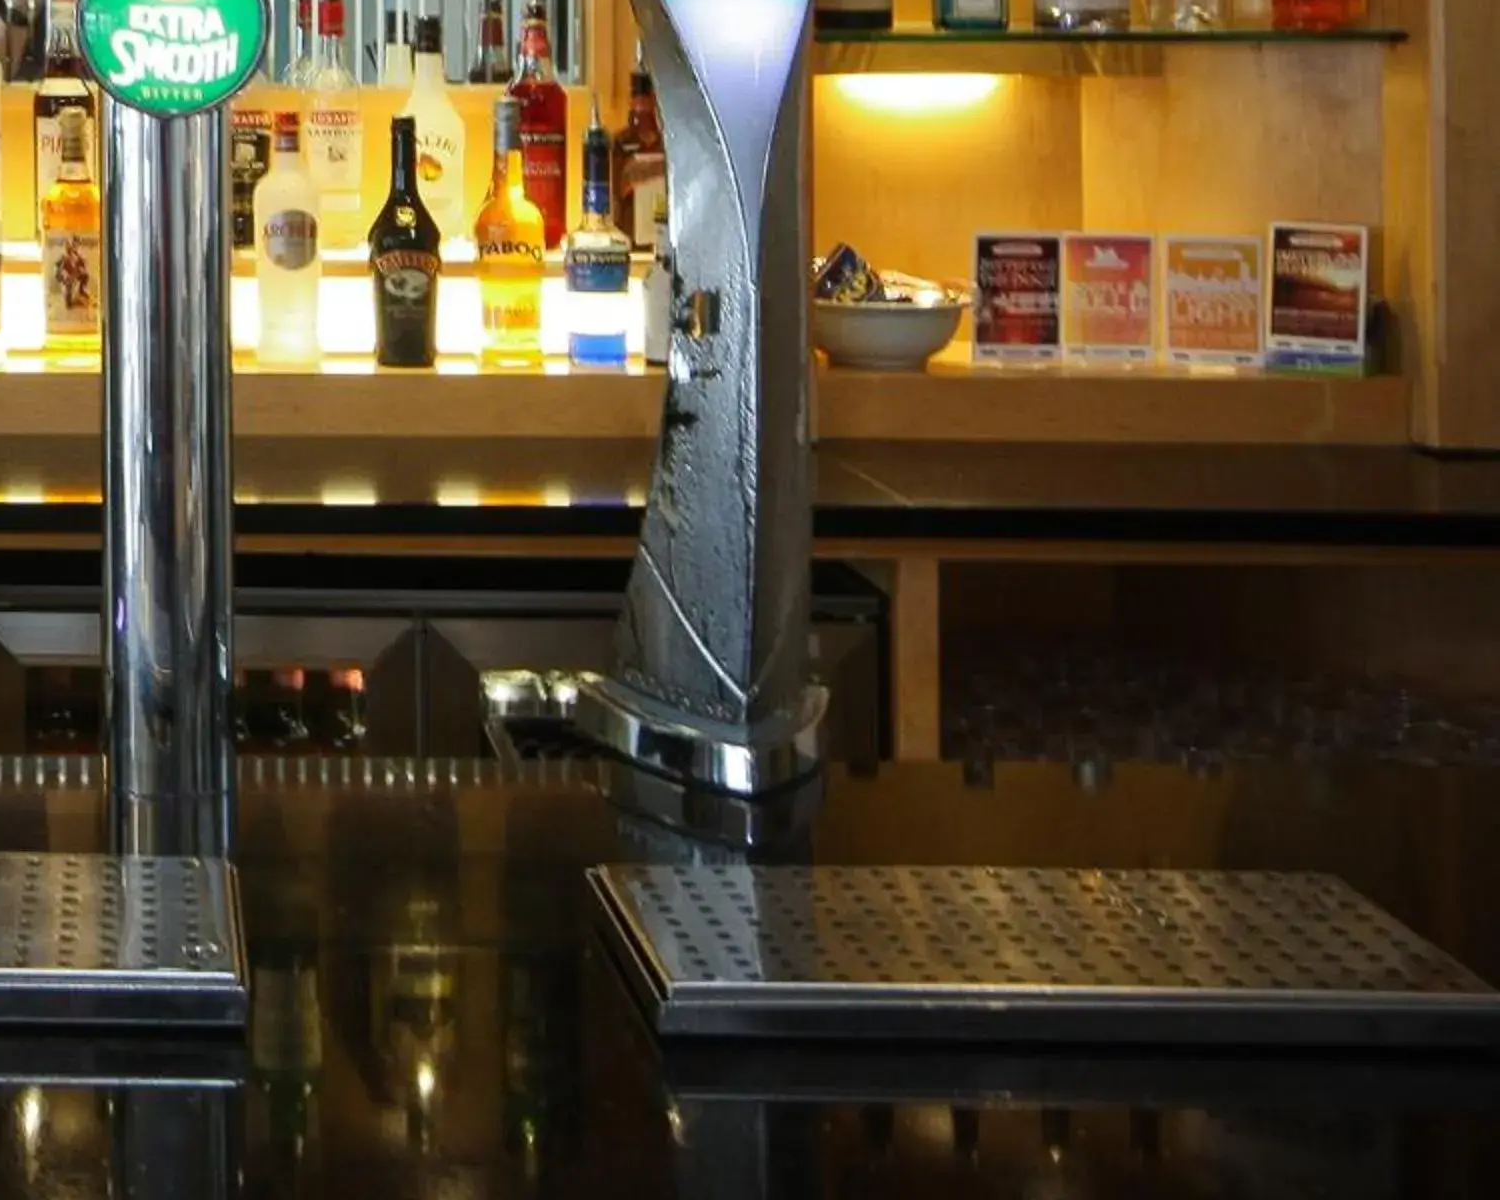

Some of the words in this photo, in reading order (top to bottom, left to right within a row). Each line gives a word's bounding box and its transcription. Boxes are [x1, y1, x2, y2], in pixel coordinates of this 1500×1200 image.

[127, 4, 226, 43] EXTRA
[108, 28, 239, 87] SMOOTH
[140, 85, 203, 101] BITTER
[479, 240, 543, 262] TABOO
